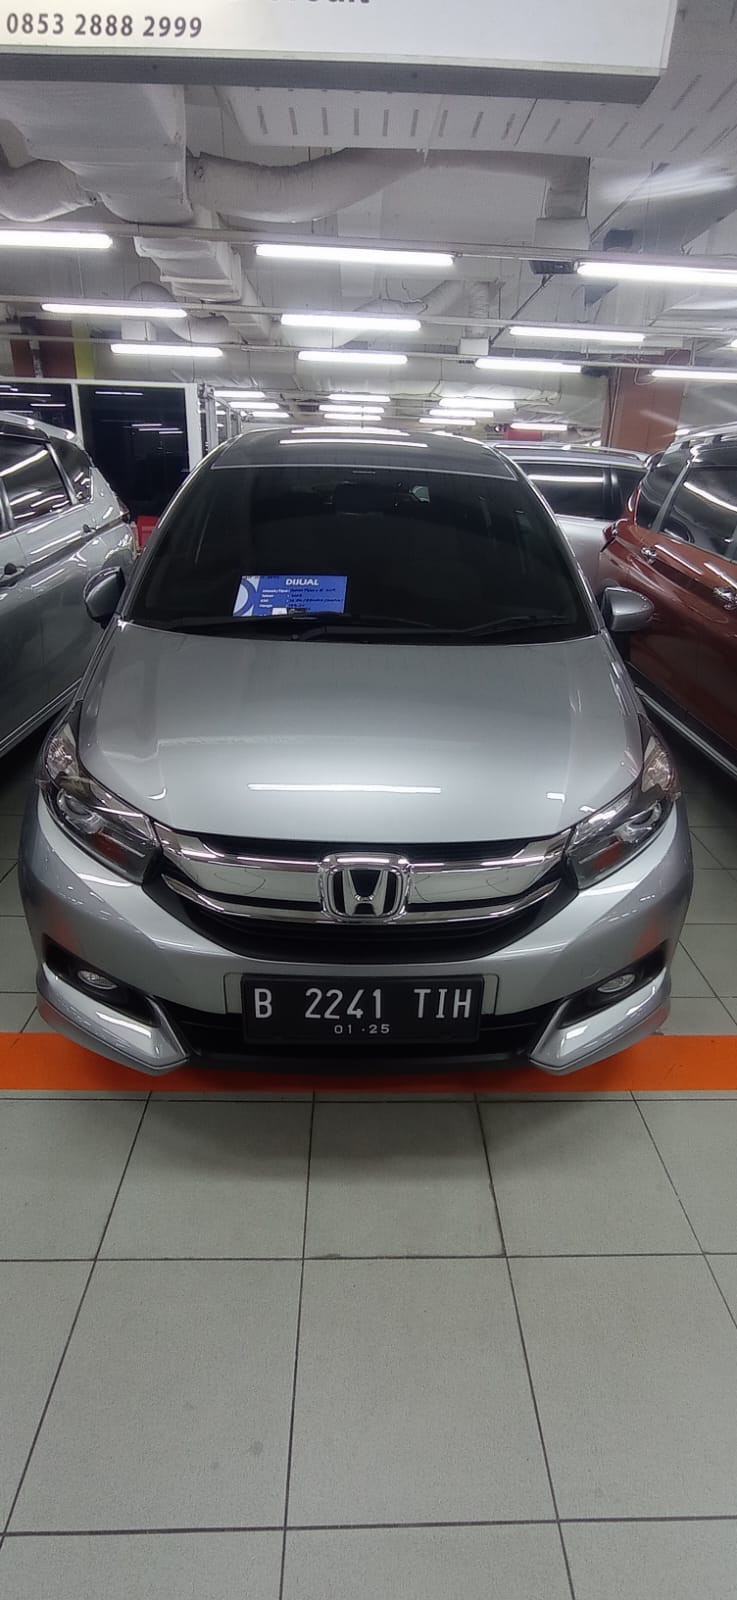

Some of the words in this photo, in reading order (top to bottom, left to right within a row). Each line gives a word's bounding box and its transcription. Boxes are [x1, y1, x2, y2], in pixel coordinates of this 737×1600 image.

[6, 13, 64, 34] 0853
[74, 14, 133, 36] 2888
[142, 16, 202, 38] 2999
[285, 578, 319, 586] DIJUAL
[254, 988, 273, 1019] B
[305, 988, 382, 1020] 2241
[413, 988, 472, 1019] TIH
